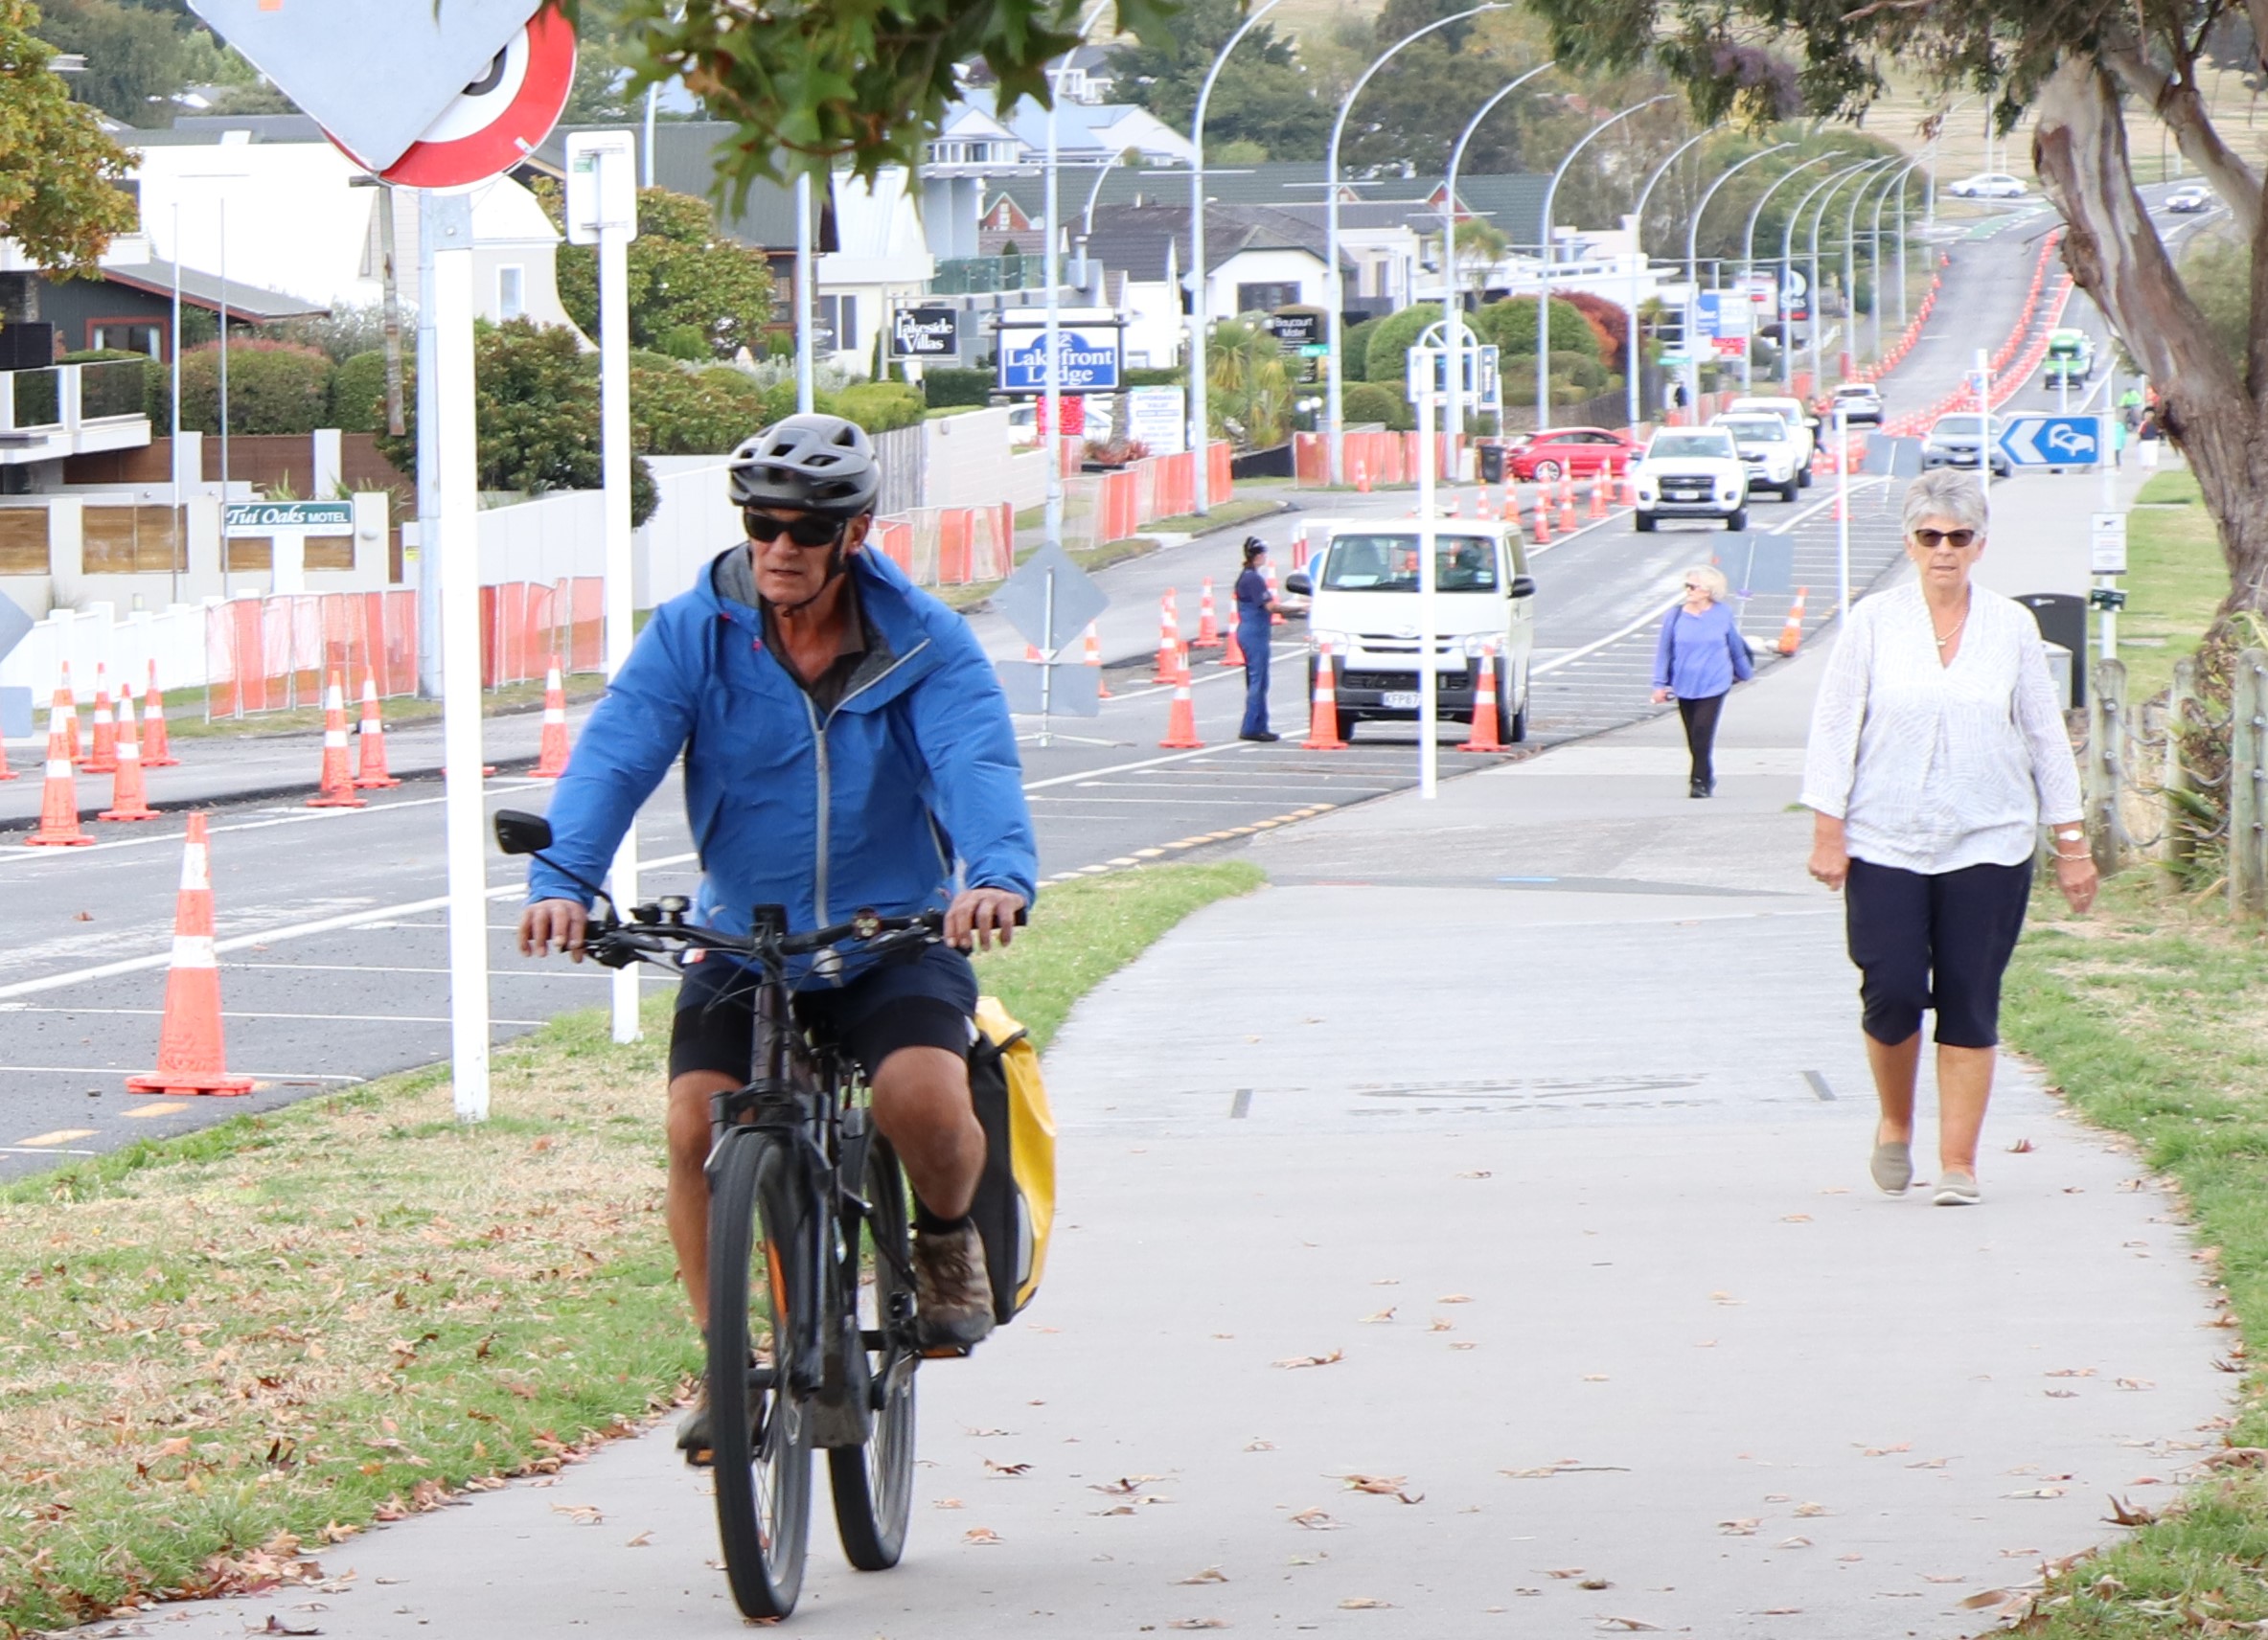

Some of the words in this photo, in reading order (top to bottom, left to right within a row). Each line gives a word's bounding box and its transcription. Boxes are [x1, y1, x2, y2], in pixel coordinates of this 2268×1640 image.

[897, 316, 953, 338] Lakeside
[1275, 317, 1314, 329] Baycourt
[903, 332, 945, 353] Villas
[1282, 329, 1307, 337] Motel
[1008, 348, 1113, 367] Lakfront
[226, 506, 261, 525] Tui
[262, 504, 306, 524] Oaks
[309, 512, 348, 522] MOTEL
[1385, 694, 1420, 706] KFP87
